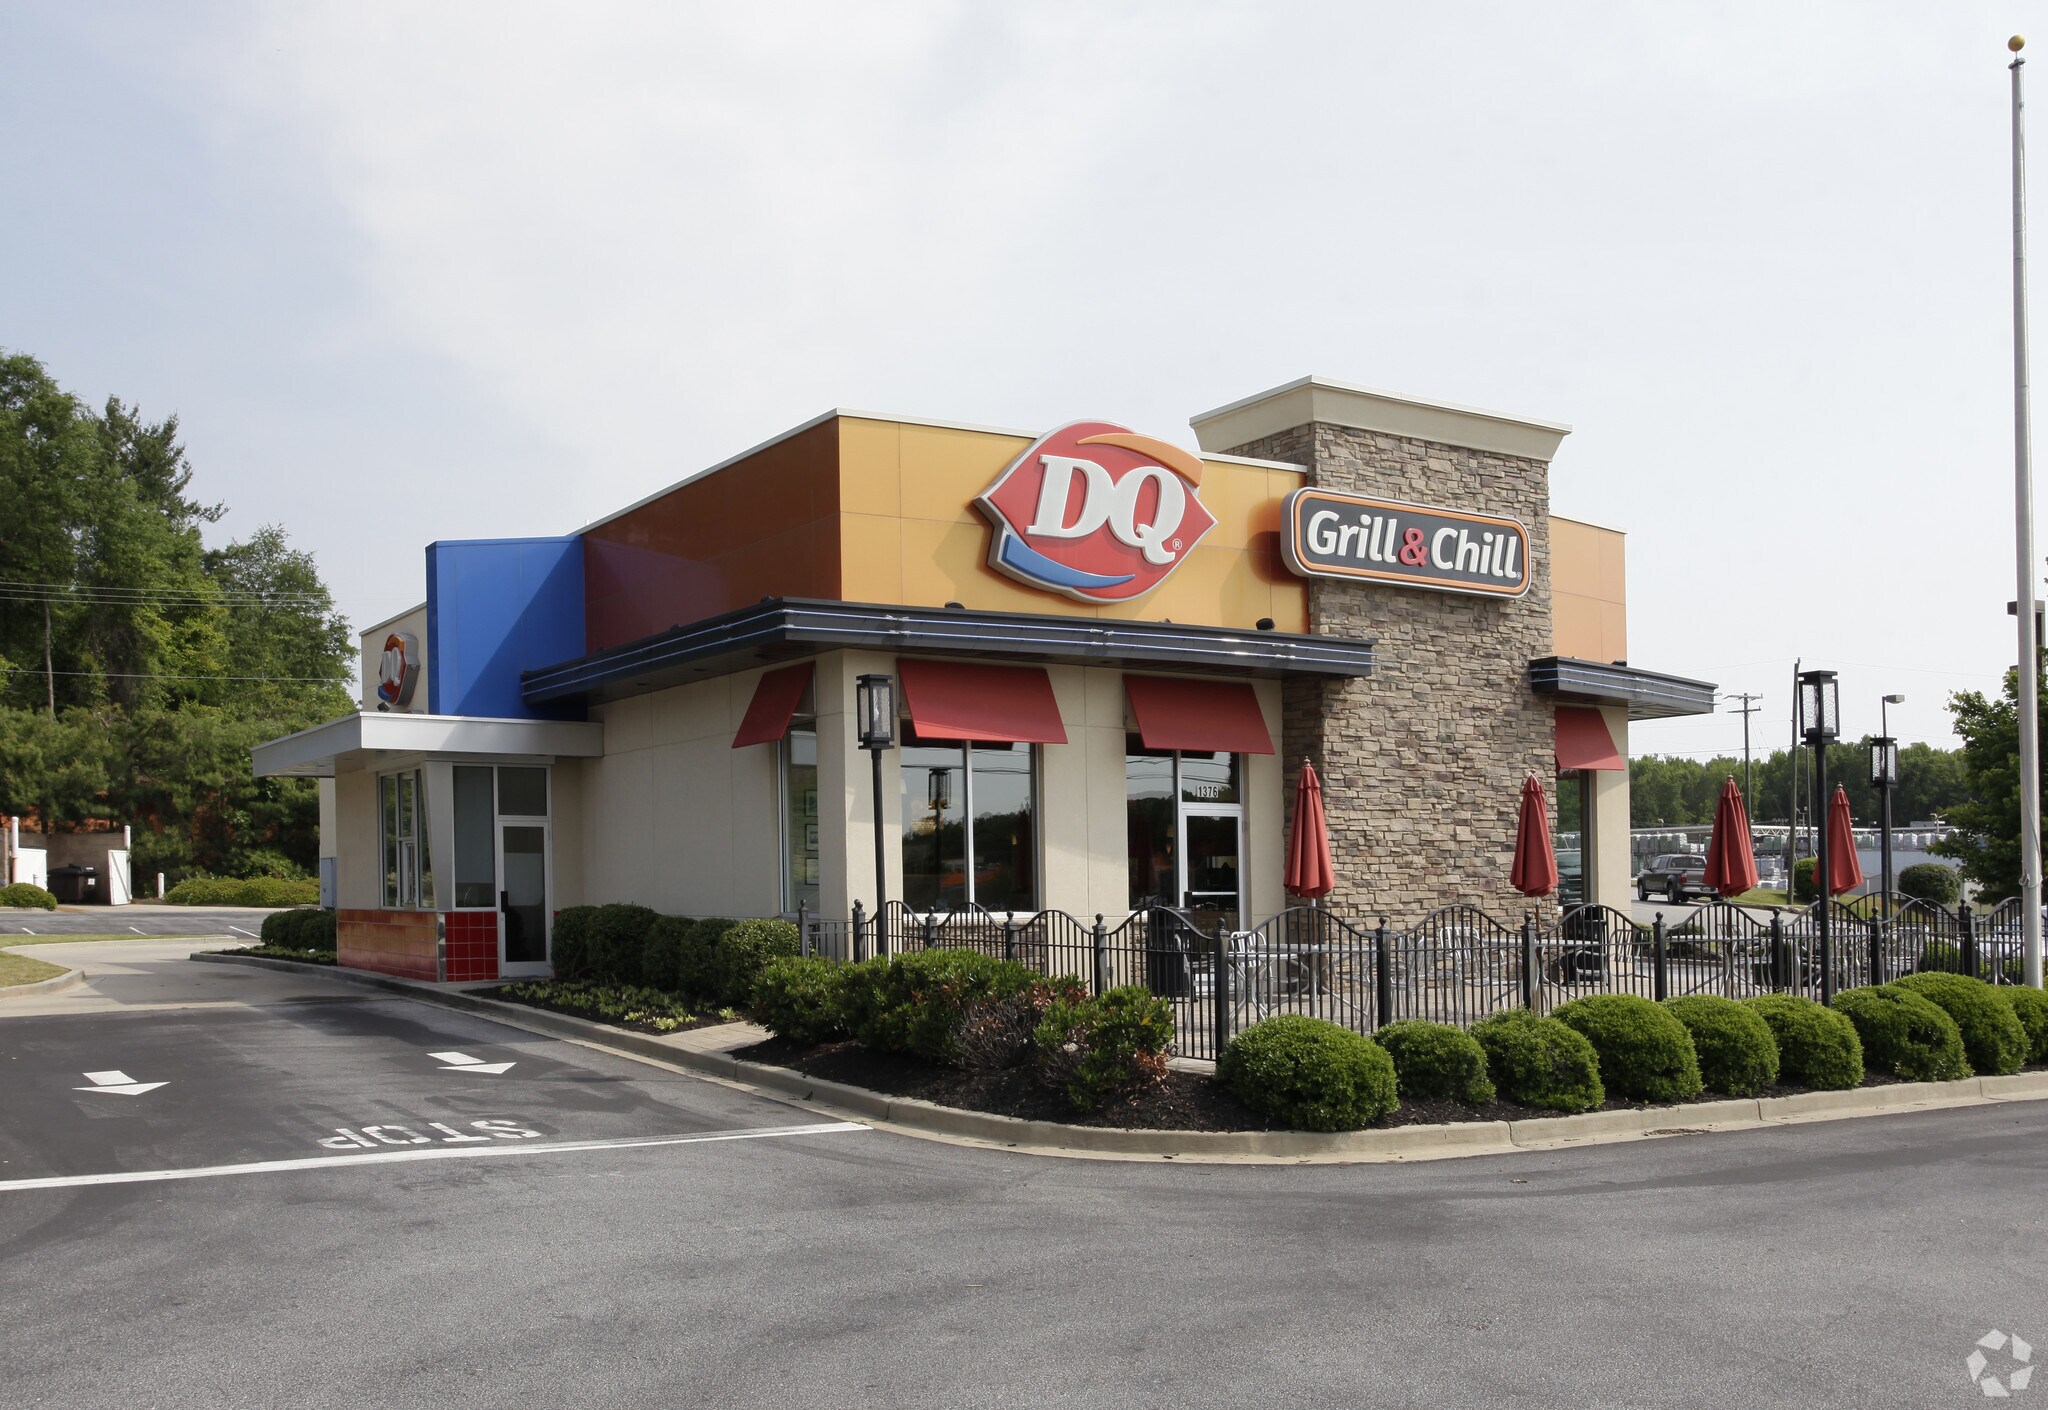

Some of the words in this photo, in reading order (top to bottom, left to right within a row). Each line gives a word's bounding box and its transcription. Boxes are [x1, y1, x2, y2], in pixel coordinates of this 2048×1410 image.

[1024, 453, 1186, 565] DQ
[1198, 785, 1218, 798] 1376
[317, 1119, 542, 1149] STOP
